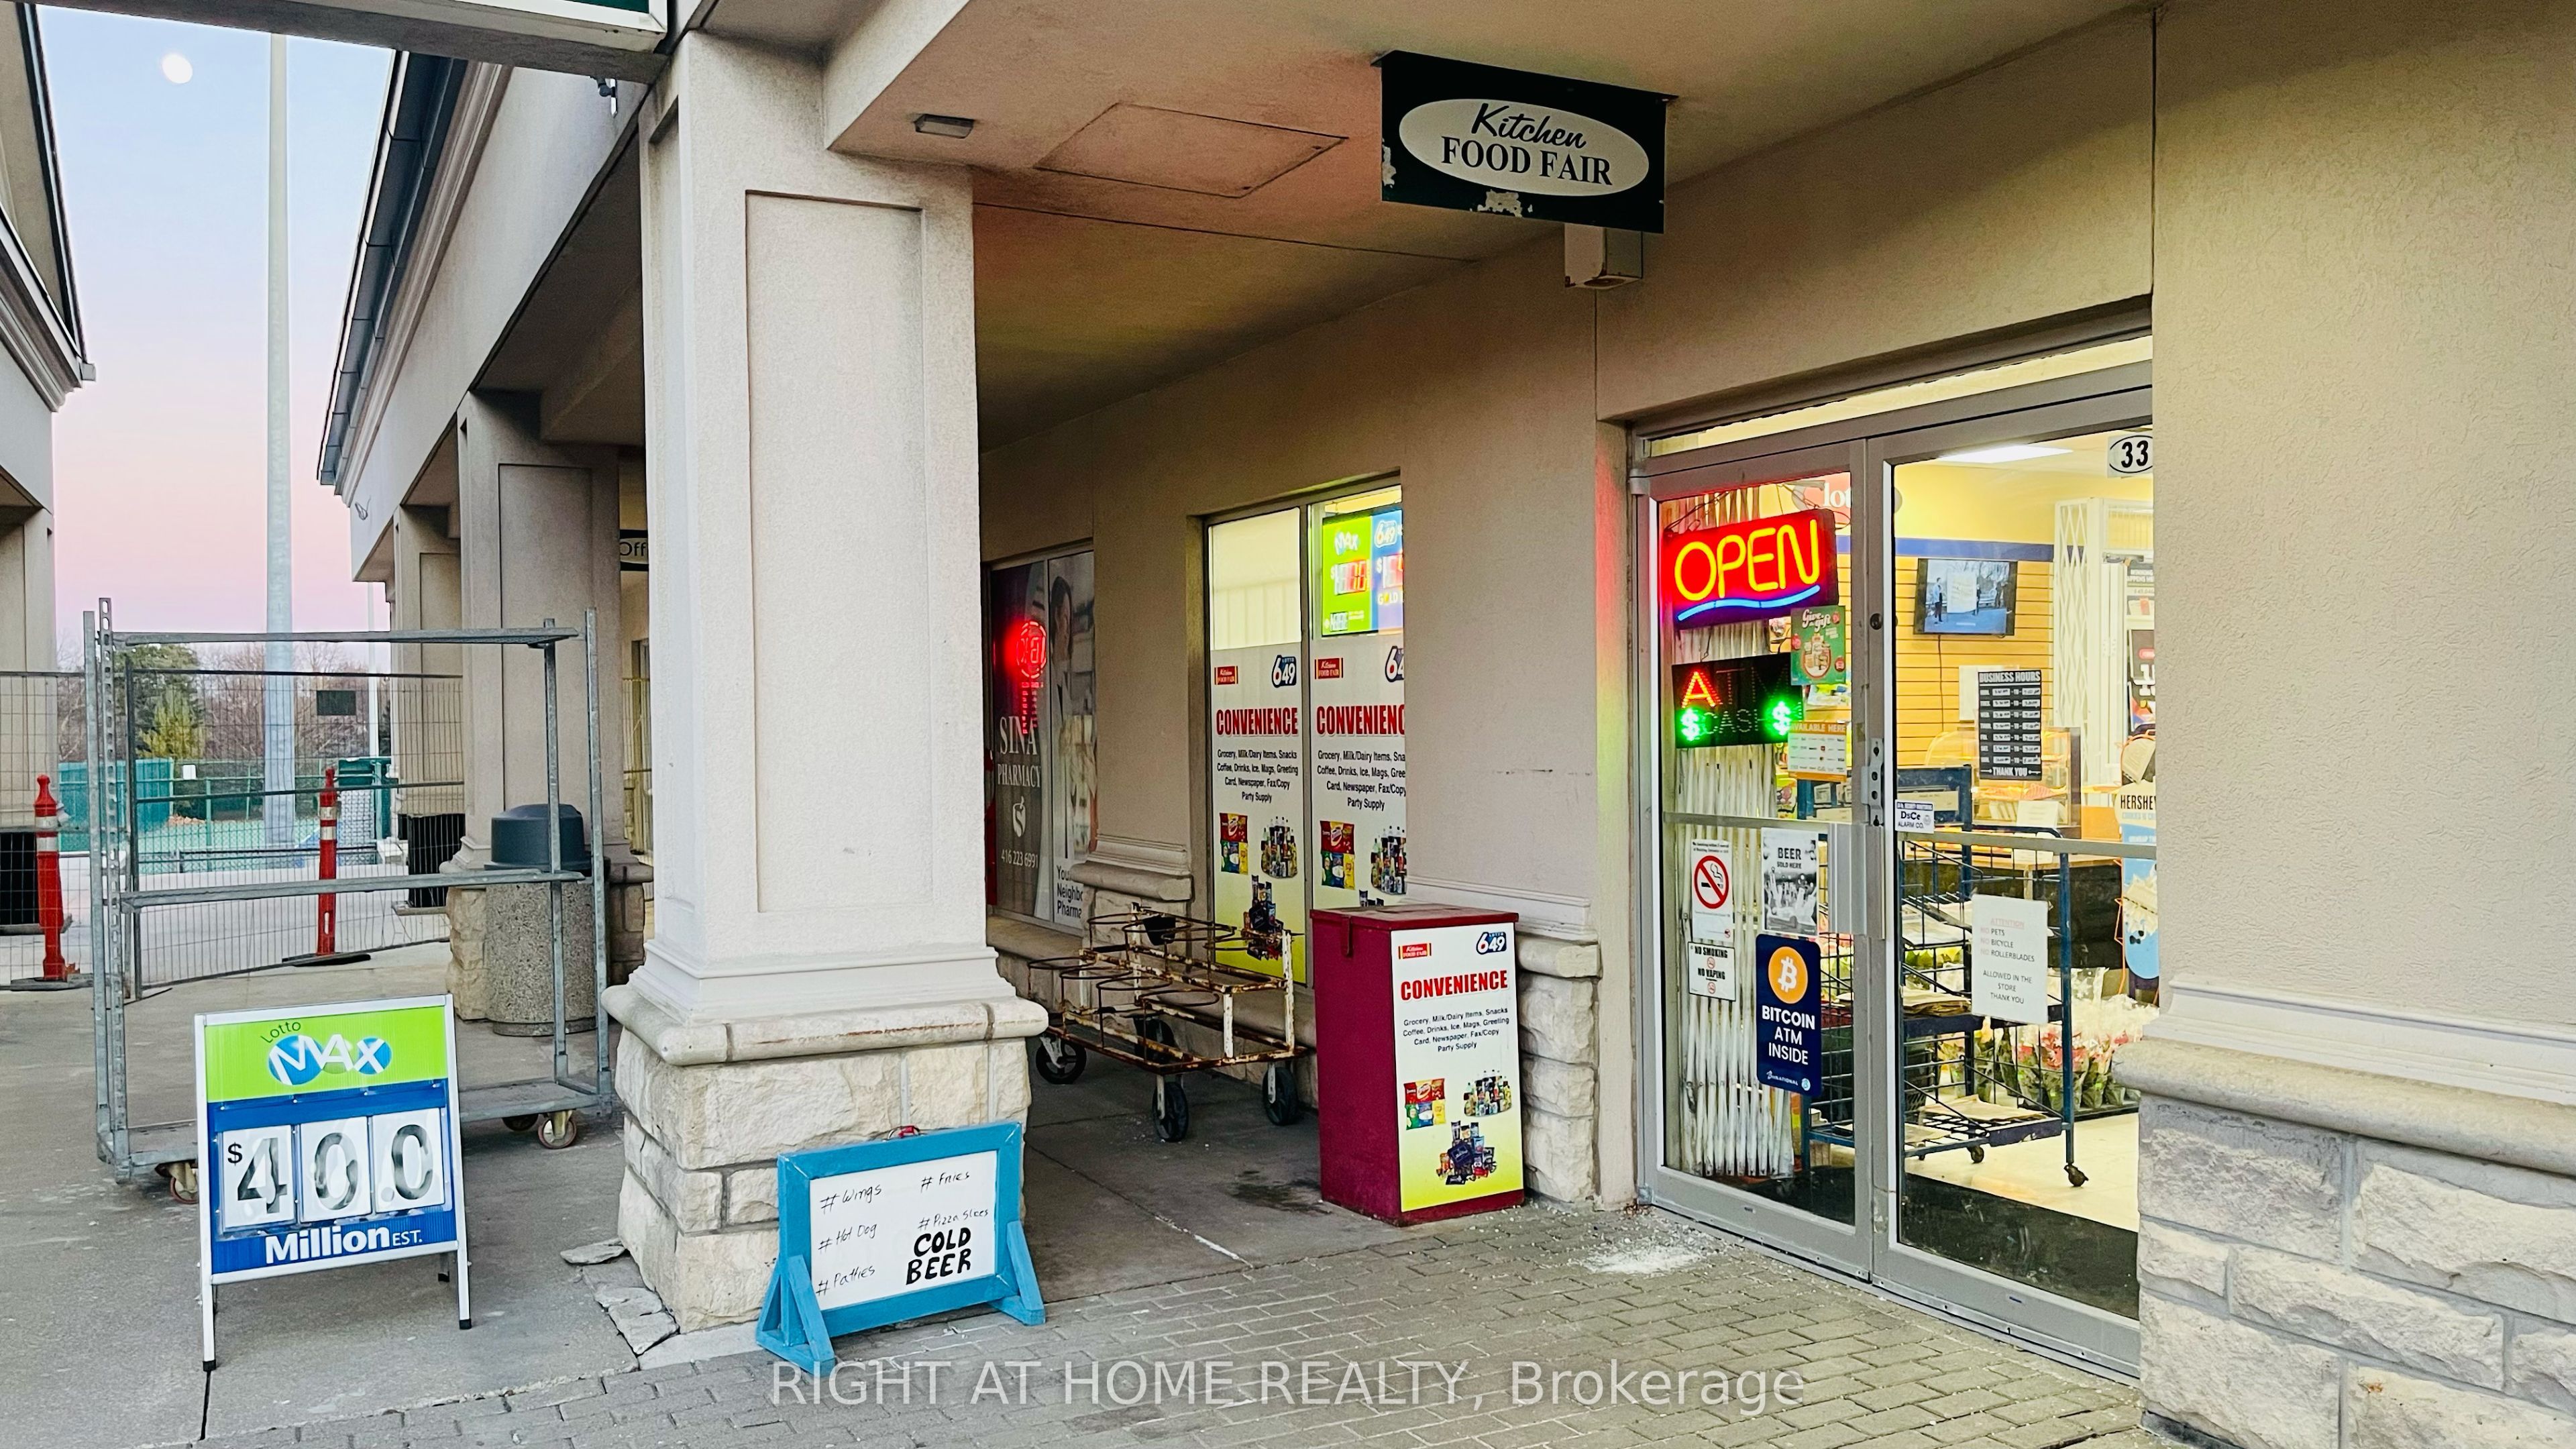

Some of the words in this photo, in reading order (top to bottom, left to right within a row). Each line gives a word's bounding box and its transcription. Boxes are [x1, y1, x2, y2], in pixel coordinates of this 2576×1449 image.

[1471, 103, 1587, 149] Kitchen
[1441, 136, 1531, 173] FOOD
[1540, 150, 1613, 186] FAIR
[2121, 440, 2149, 468] 33
[1674, 519, 1820, 601] OPEN
[1273, 657, 1296, 686] 649
[1980, 672, 2014, 683] BUSINESS
[2015, 672, 2040, 682] HOURS
[1216, 707, 1298, 735] CONVENIENCE
[1000, 715, 1038, 755] SINA
[1279, 750, 1297, 759] Snacks
[1343, 751, 1372, 763] Milk/Dairy
[998, 763, 1040, 788] PHARMACY
[1277, 763, 1298, 776] Greeting
[2014, 767, 2028, 777] YOU
[1242, 791, 1254, 802] Party
[1255, 792, 1272, 804] Supply
[1347, 797, 1363, 810] Party
[1364, 798, 1385, 812] Supply
[1001, 849, 1012, 865] 416
[1013, 850, 1024, 867] 223
[1778, 847, 1801, 860] BEER
[1057, 865, 1071, 881] You
[1991, 928, 2005, 936] PETS
[1477, 932, 1505, 954] 649
[1991, 939, 2013, 949] BICYCLE
[1695, 946, 1702, 955] NO
[1703, 947, 1728, 959] SMOKING
[1991, 950, 2035, 962] ROLLERBLADES
[1698, 967, 1705, 977] NO
[1705, 969, 1725, 980] VAPING
[1983, 969, 2012, 980] ALLOWED
[2013, 974, 2019, 982] IN
[2021, 975, 2033, 984] THE
[1401, 970, 1508, 1001] CONVENIENCE
[1998, 982, 2017, 992] STORE
[1990, 992, 2010, 1002] THANK
[2011, 996, 2025, 1004] YOU
[1432, 1013, 1464, 1023] Milk/Dairy
[1485, 1008, 1508, 1016] Snacks
[1483, 1016, 1509, 1027] Greeting
[1762, 1006, 1815, 1030] BITCOIN
[260, 1020, 301, 1044] Lotto
[1470, 1028, 1499, 1038] Fax/Copy
[1774, 1026, 1803, 1045] ATM
[1438, 1044, 1454, 1053] Party
[1456, 1042, 1477, 1053] Supply
[1768, 1042, 1809, 1065] INSIDE
[268, 1033, 386, 1085] MAX
[842, 1183, 882, 1205] Wings
[392, 1230, 423, 1246] EST.
[835, 1226, 855, 1243] Hot
[857, 1223, 879, 1240] Dog
[266, 1225, 391, 1264] Million
[914, 1227, 972, 1258] COLD
[906, 1248, 972, 1285] BEER
